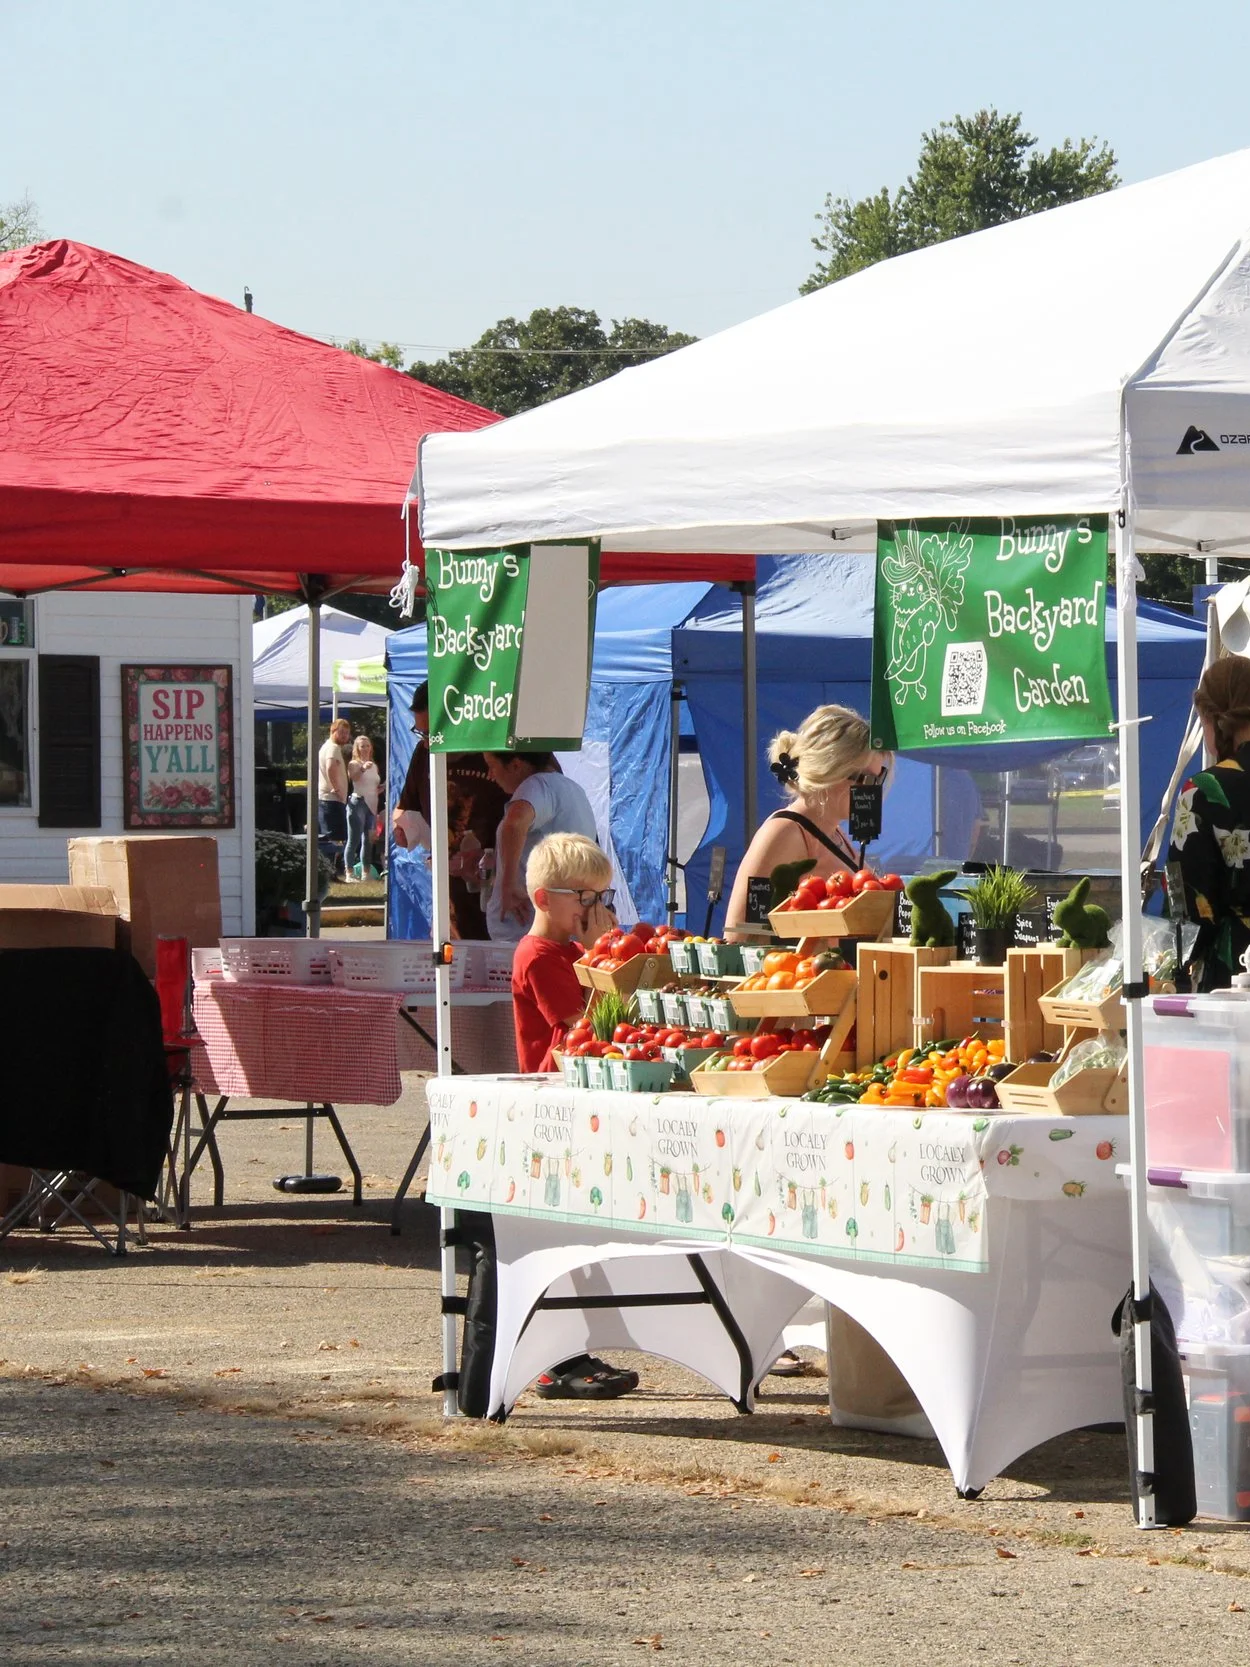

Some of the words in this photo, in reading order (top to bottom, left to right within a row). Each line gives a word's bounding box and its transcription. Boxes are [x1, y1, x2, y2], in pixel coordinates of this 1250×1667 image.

[996, 514, 1093, 573] Bunnys
[436, 549, 520, 602] Bunnys
[984, 581, 1103, 652] Backyard
[1013, 663, 1090, 713] Garden
[152, 689, 205, 720] SIP
[143, 723, 213, 741] HAPPENS
[923, 723, 945, 740] Follow
[946, 726, 955, 735] us
[956, 725, 967, 735] on
[967, 719, 1007, 736] Facebook
[144, 745, 215, 773] Y'ALL
[920, 1164, 967, 1184] GROWN
